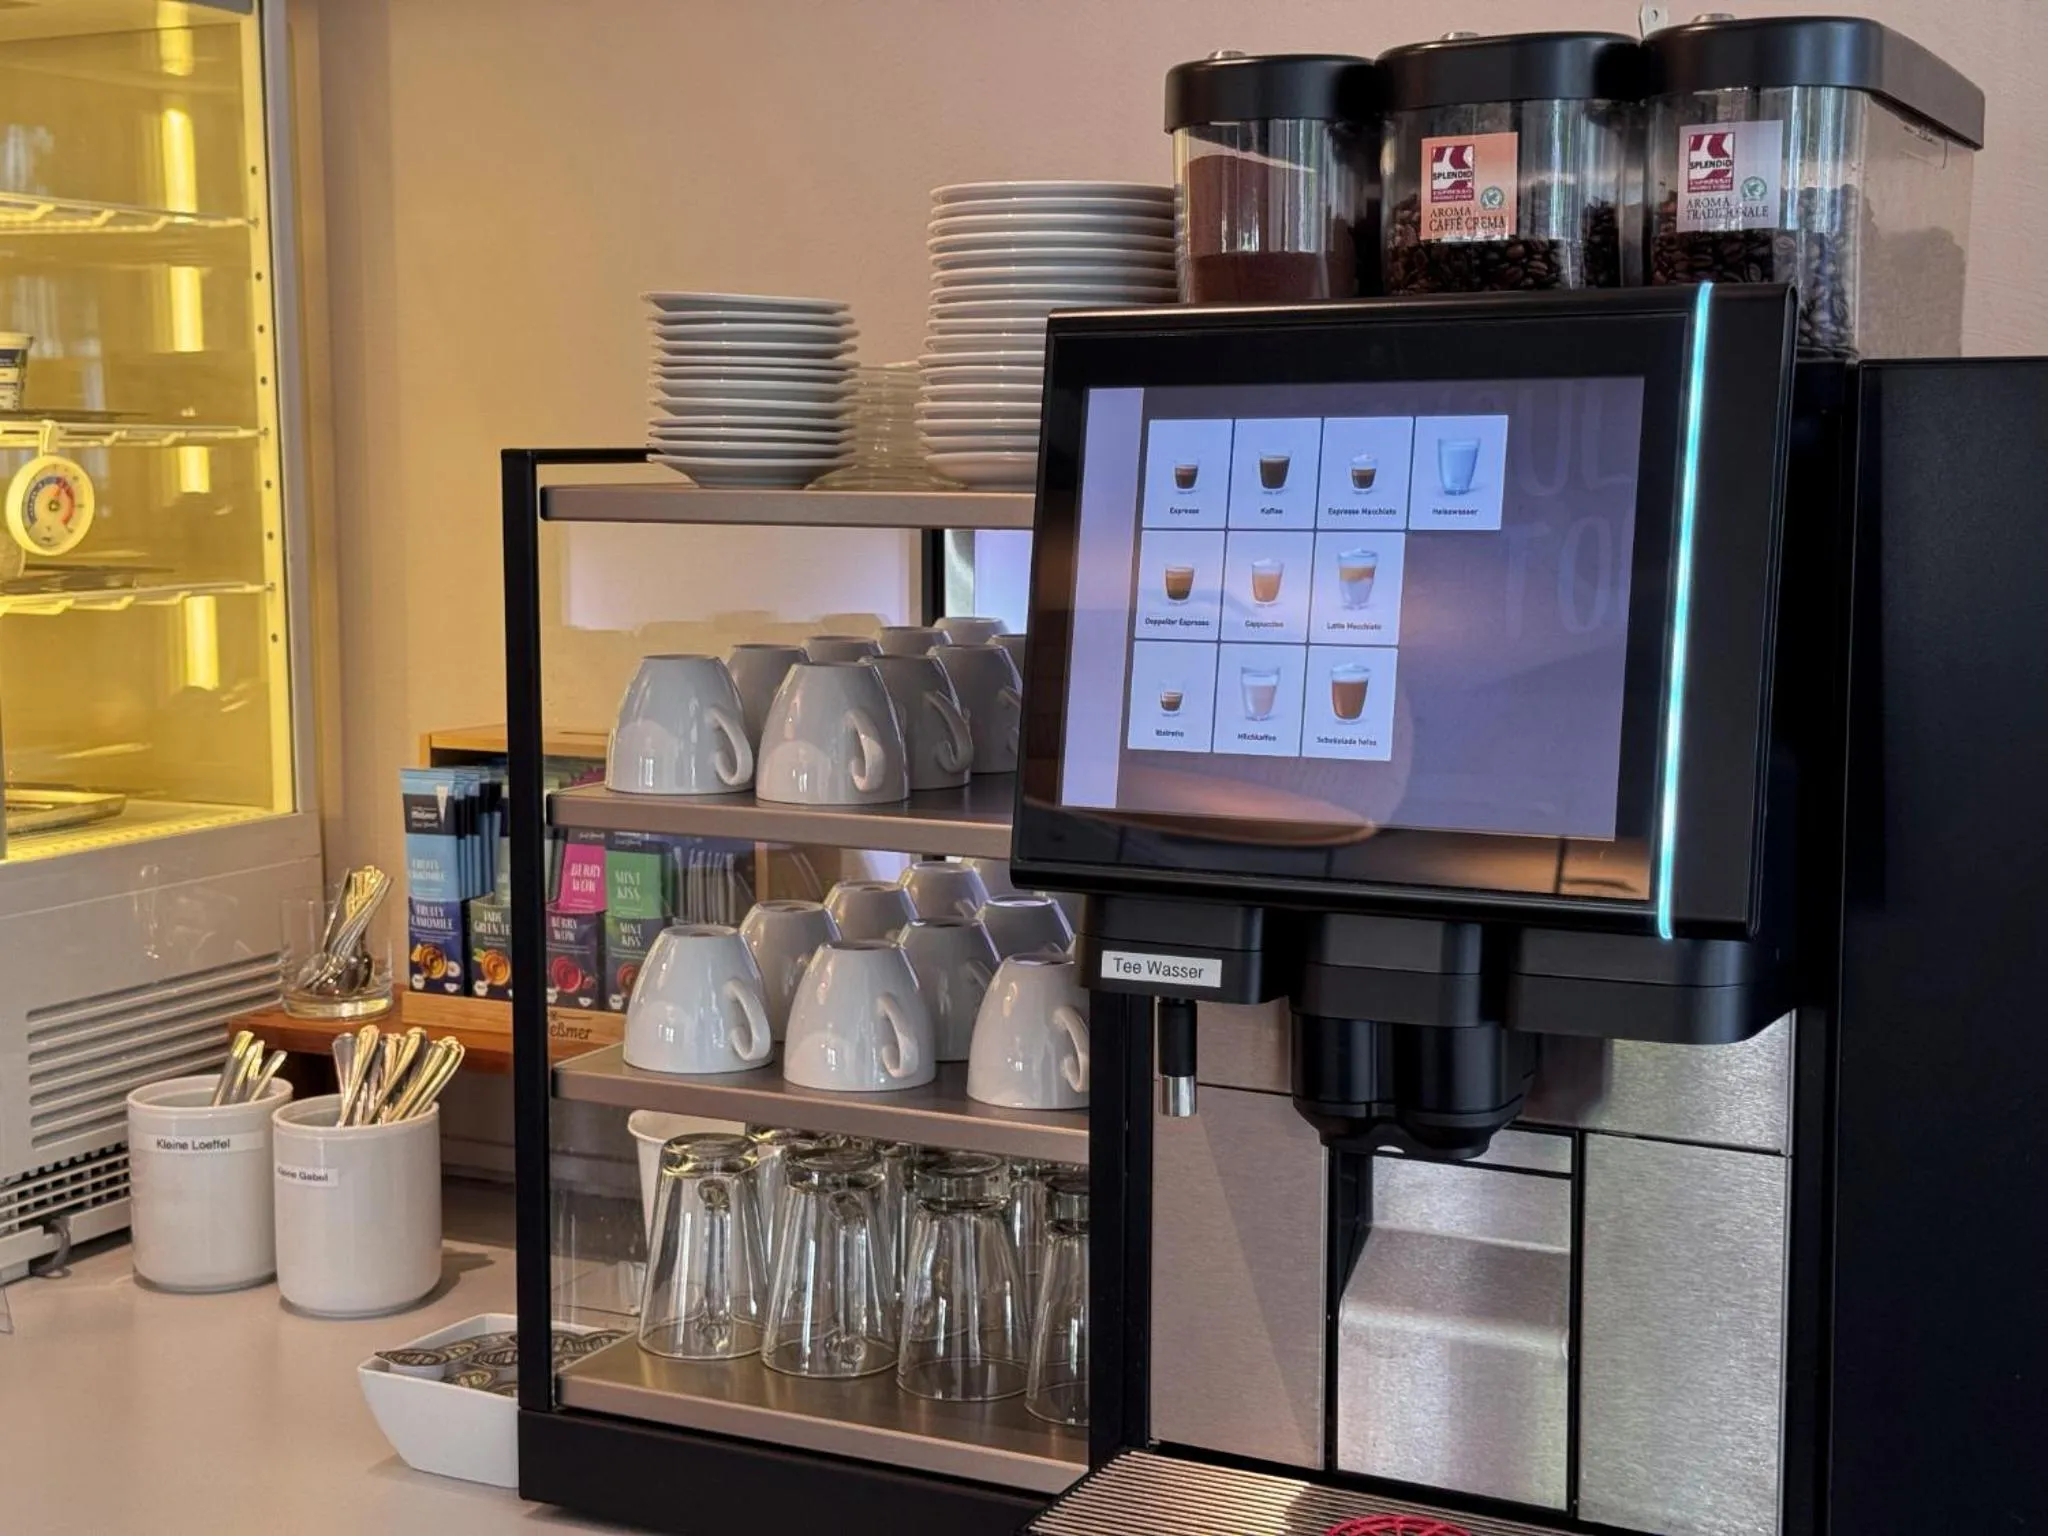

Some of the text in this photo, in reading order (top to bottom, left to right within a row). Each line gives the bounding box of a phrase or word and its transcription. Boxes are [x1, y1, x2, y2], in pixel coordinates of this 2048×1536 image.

[1432, 170, 1473, 180] SPLENDID
[1687, 197, 1730, 209] AROMA
[1430, 206, 1472, 217] AROMA
[1465, 216, 1506, 231] CREMA
[1169, 507, 1200, 515] Espresso
[1260, 507, 1284, 515] Kaffee
[1328, 507, 1360, 516] Espresso
[1179, 618, 1210, 626] Espresso
[571, 863, 600, 877] BERRY
[615, 870, 640, 885] MINT
[616, 886, 640, 900] KISS
[551, 916, 578, 929] BERRY
[619, 921, 642, 935] MINT
[621, 934, 641, 947] KISS
[1113, 957, 1205, 979] Tee Wasser
[550, 1022, 592, 1039] eßmer
[156, 1138, 231, 1150] Kleine Loeffel
[299, 1170, 329, 1182] Gabel
